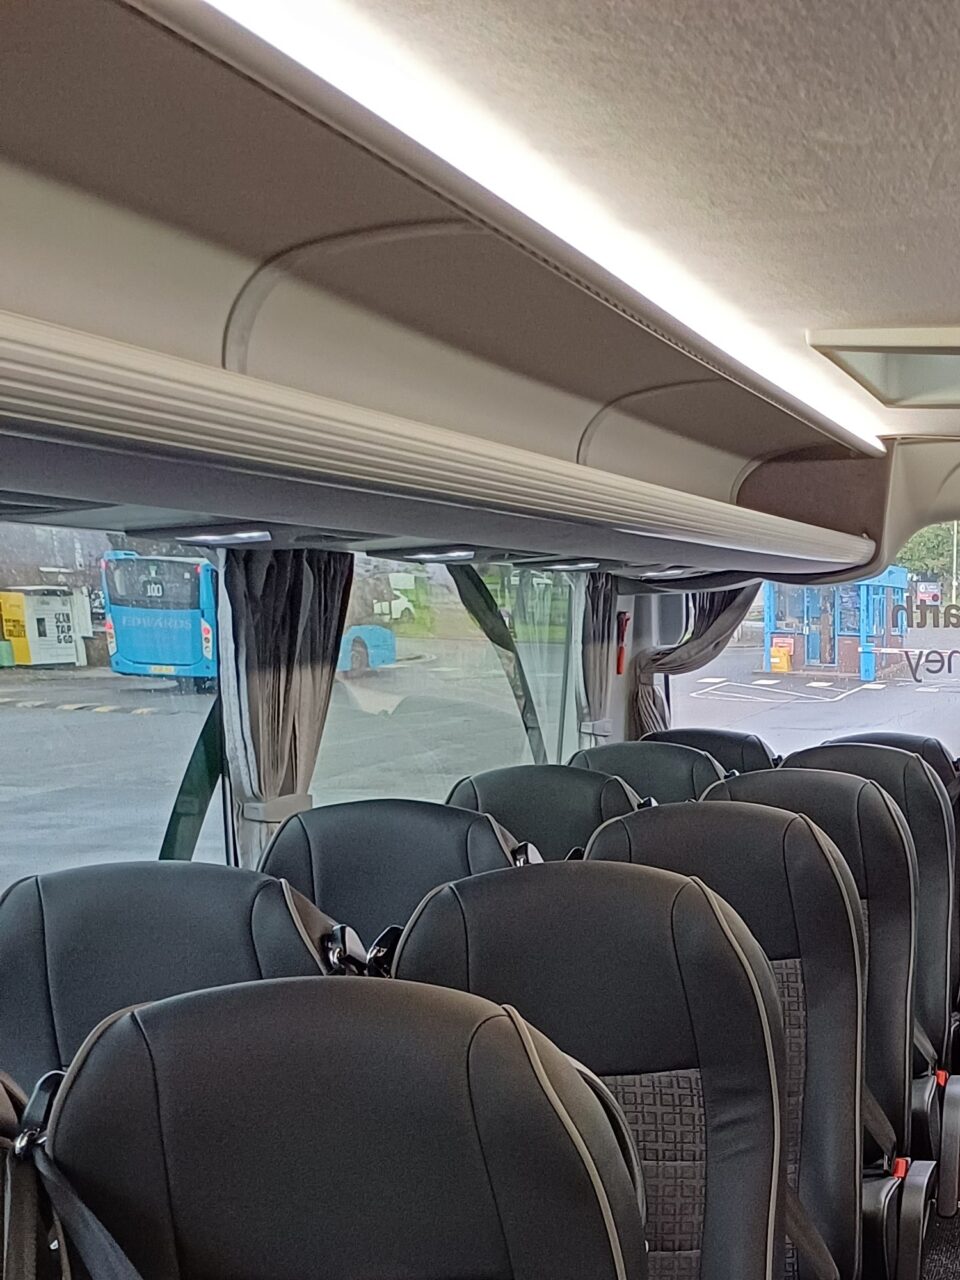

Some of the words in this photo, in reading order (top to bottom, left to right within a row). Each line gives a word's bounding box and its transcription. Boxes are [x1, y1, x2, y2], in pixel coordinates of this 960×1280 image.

[146, 584, 163, 597] 100
[54, 612, 71, 624] SCAN
[121, 615, 192, 631] EDWARDS
[55, 624, 72, 635] TAP
[63, 635, 73, 644] GO
